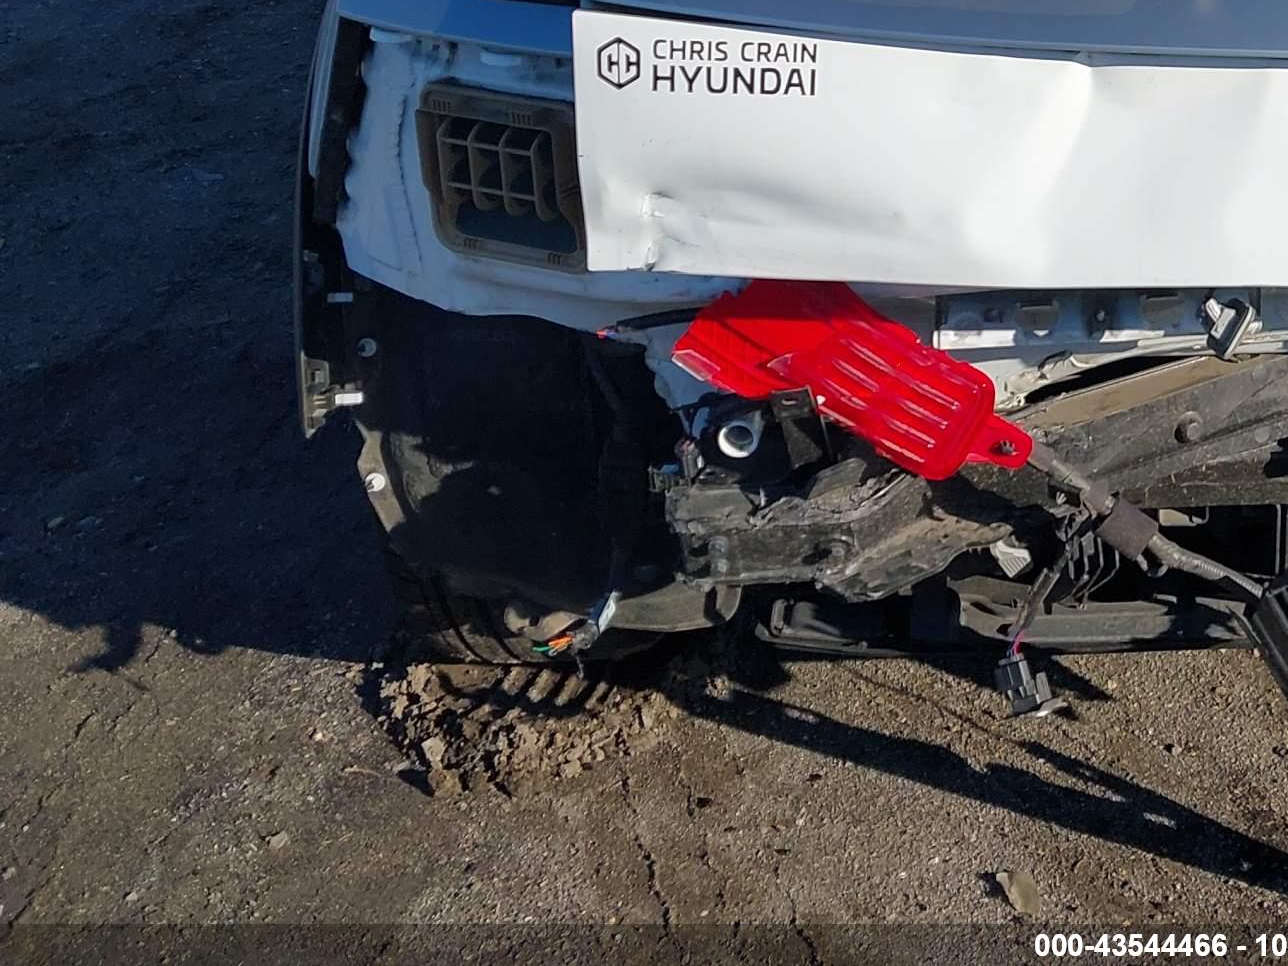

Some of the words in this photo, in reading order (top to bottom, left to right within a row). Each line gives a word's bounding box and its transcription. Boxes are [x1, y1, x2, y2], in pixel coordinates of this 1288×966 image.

[652, 39, 729, 61] CHRIS
[740, 41, 818, 63] CRAIN
[651, 65, 817, 96] HYUNDAI
